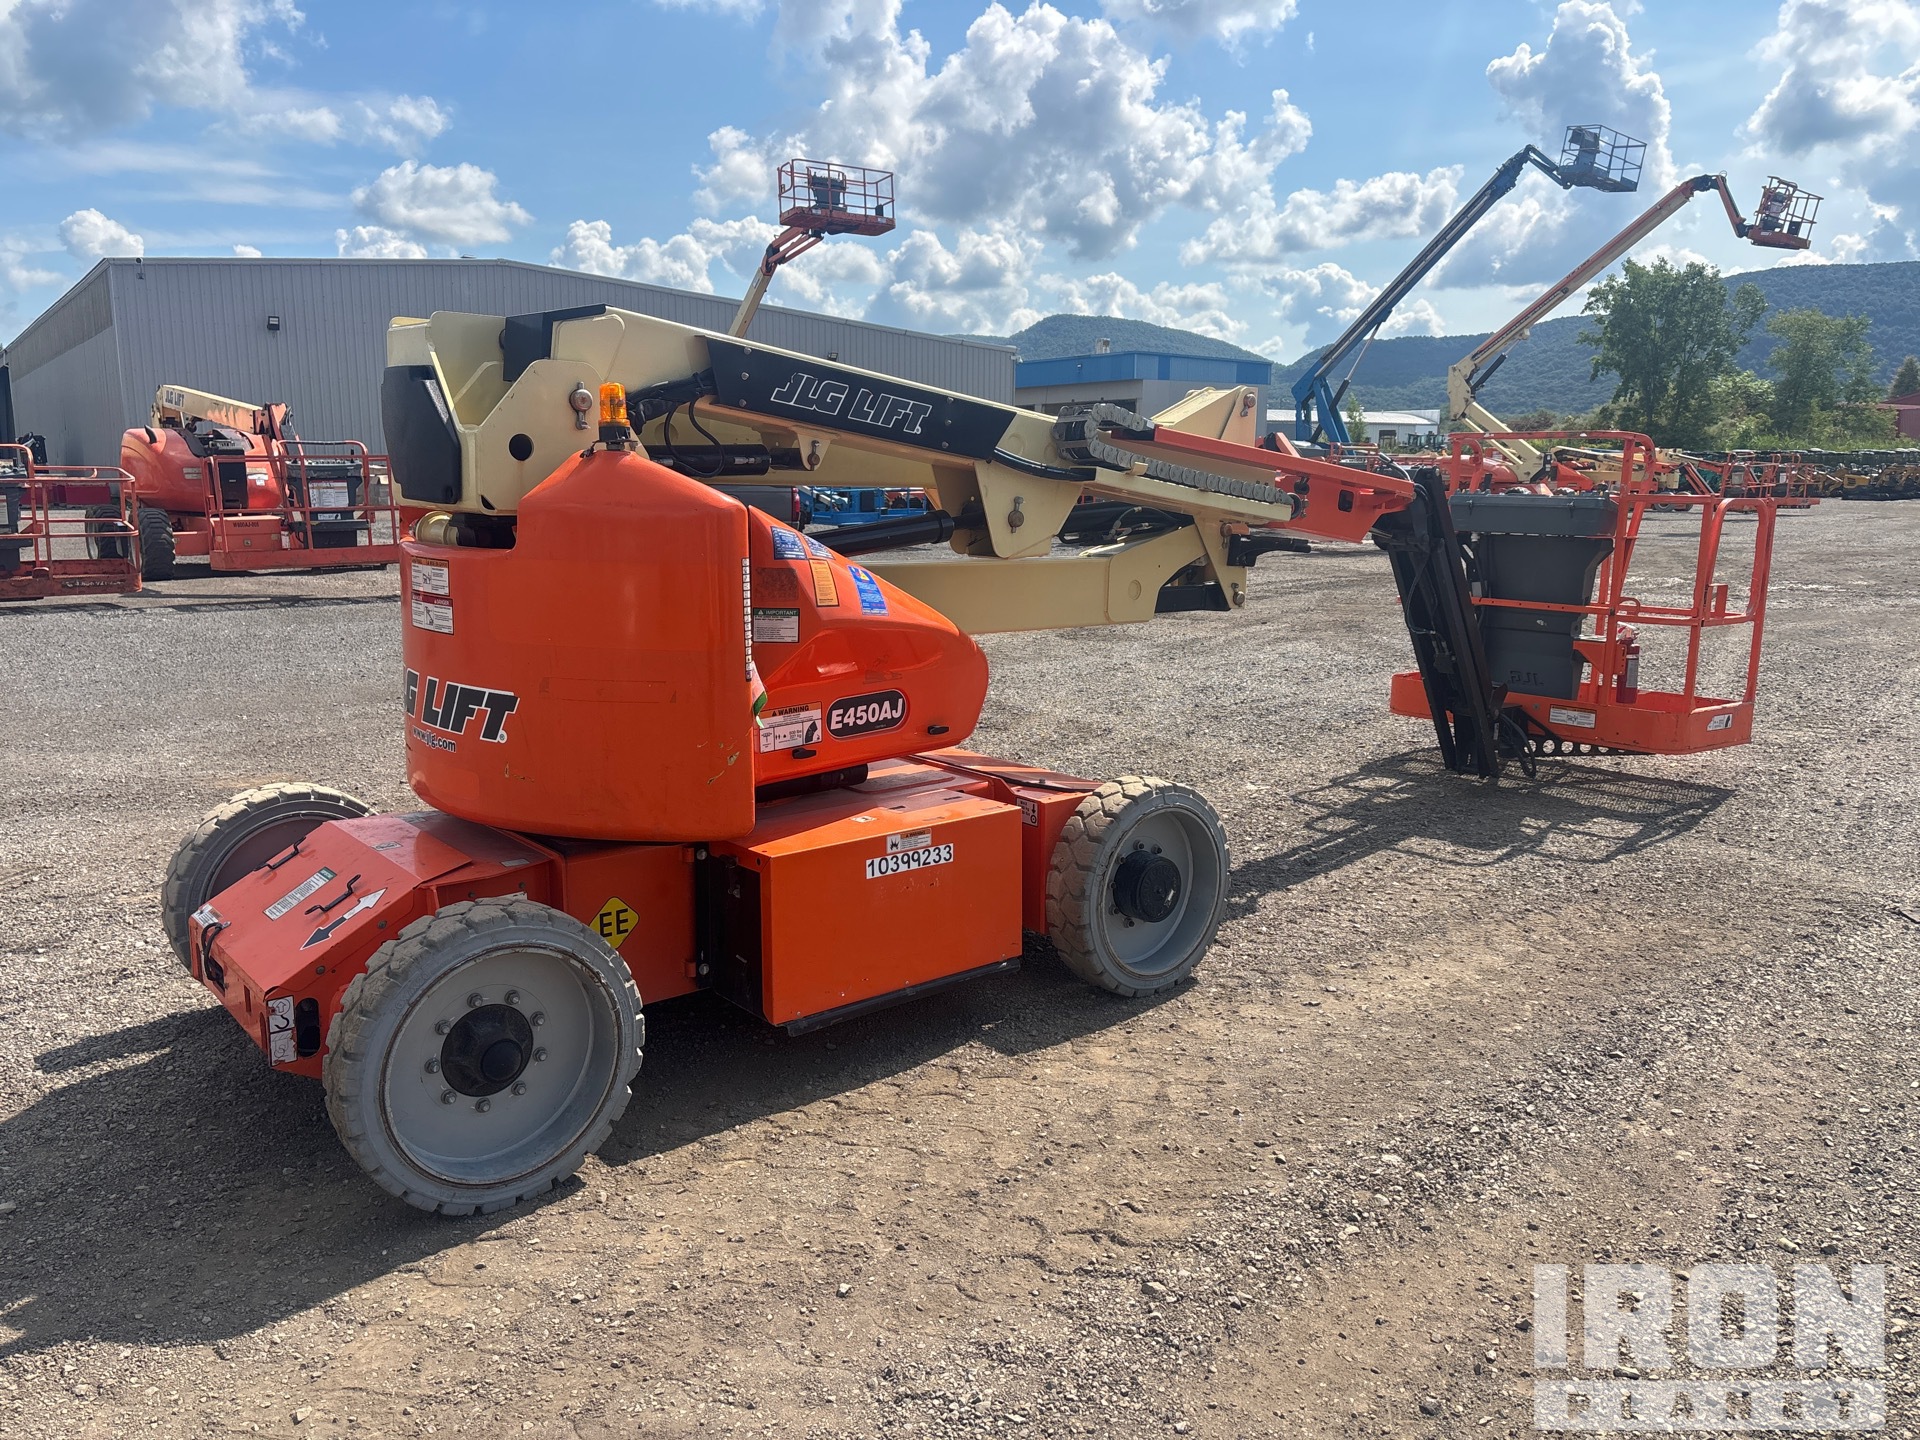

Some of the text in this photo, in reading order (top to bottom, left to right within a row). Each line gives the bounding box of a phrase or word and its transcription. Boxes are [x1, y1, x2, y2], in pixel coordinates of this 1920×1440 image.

[770, 372, 933, 434] JLG LIFT
[421, 675, 520, 743] LIFT
[777, 704, 810, 717] WARNING
[830, 698, 903, 730] E450AJ
[412, 725, 456, 753] www.jlg.com
[867, 844, 953, 877] 10399233
[599, 908, 629, 938] EE
